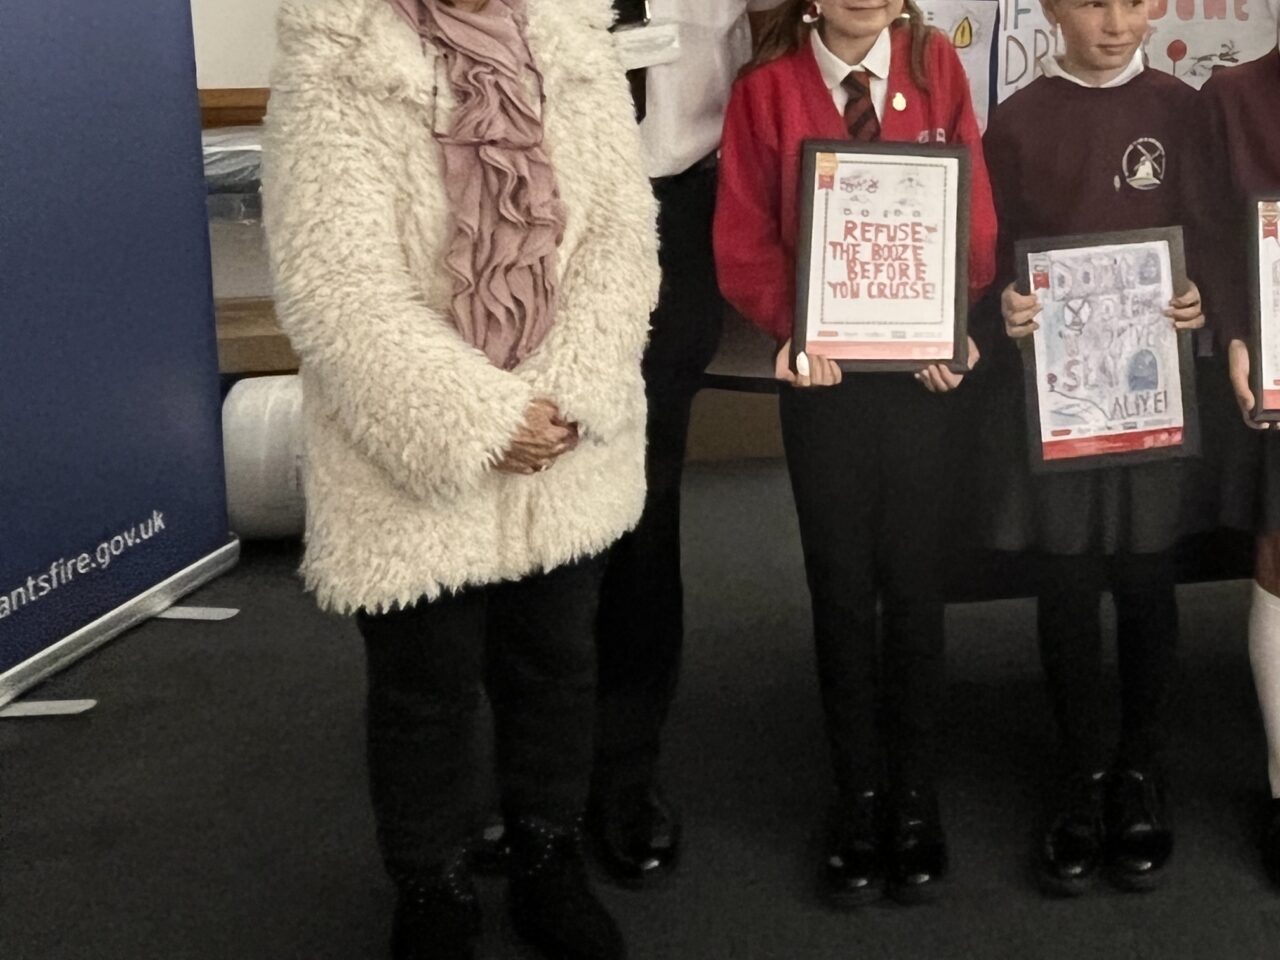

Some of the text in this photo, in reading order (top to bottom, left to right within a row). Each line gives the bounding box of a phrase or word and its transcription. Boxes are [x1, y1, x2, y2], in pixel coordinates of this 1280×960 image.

[843, 219, 926, 243] REFUSE
[828, 240, 925, 262] THE BOOZE
[846, 257, 928, 282] BEFORE
[826, 280, 861, 300] YOU
